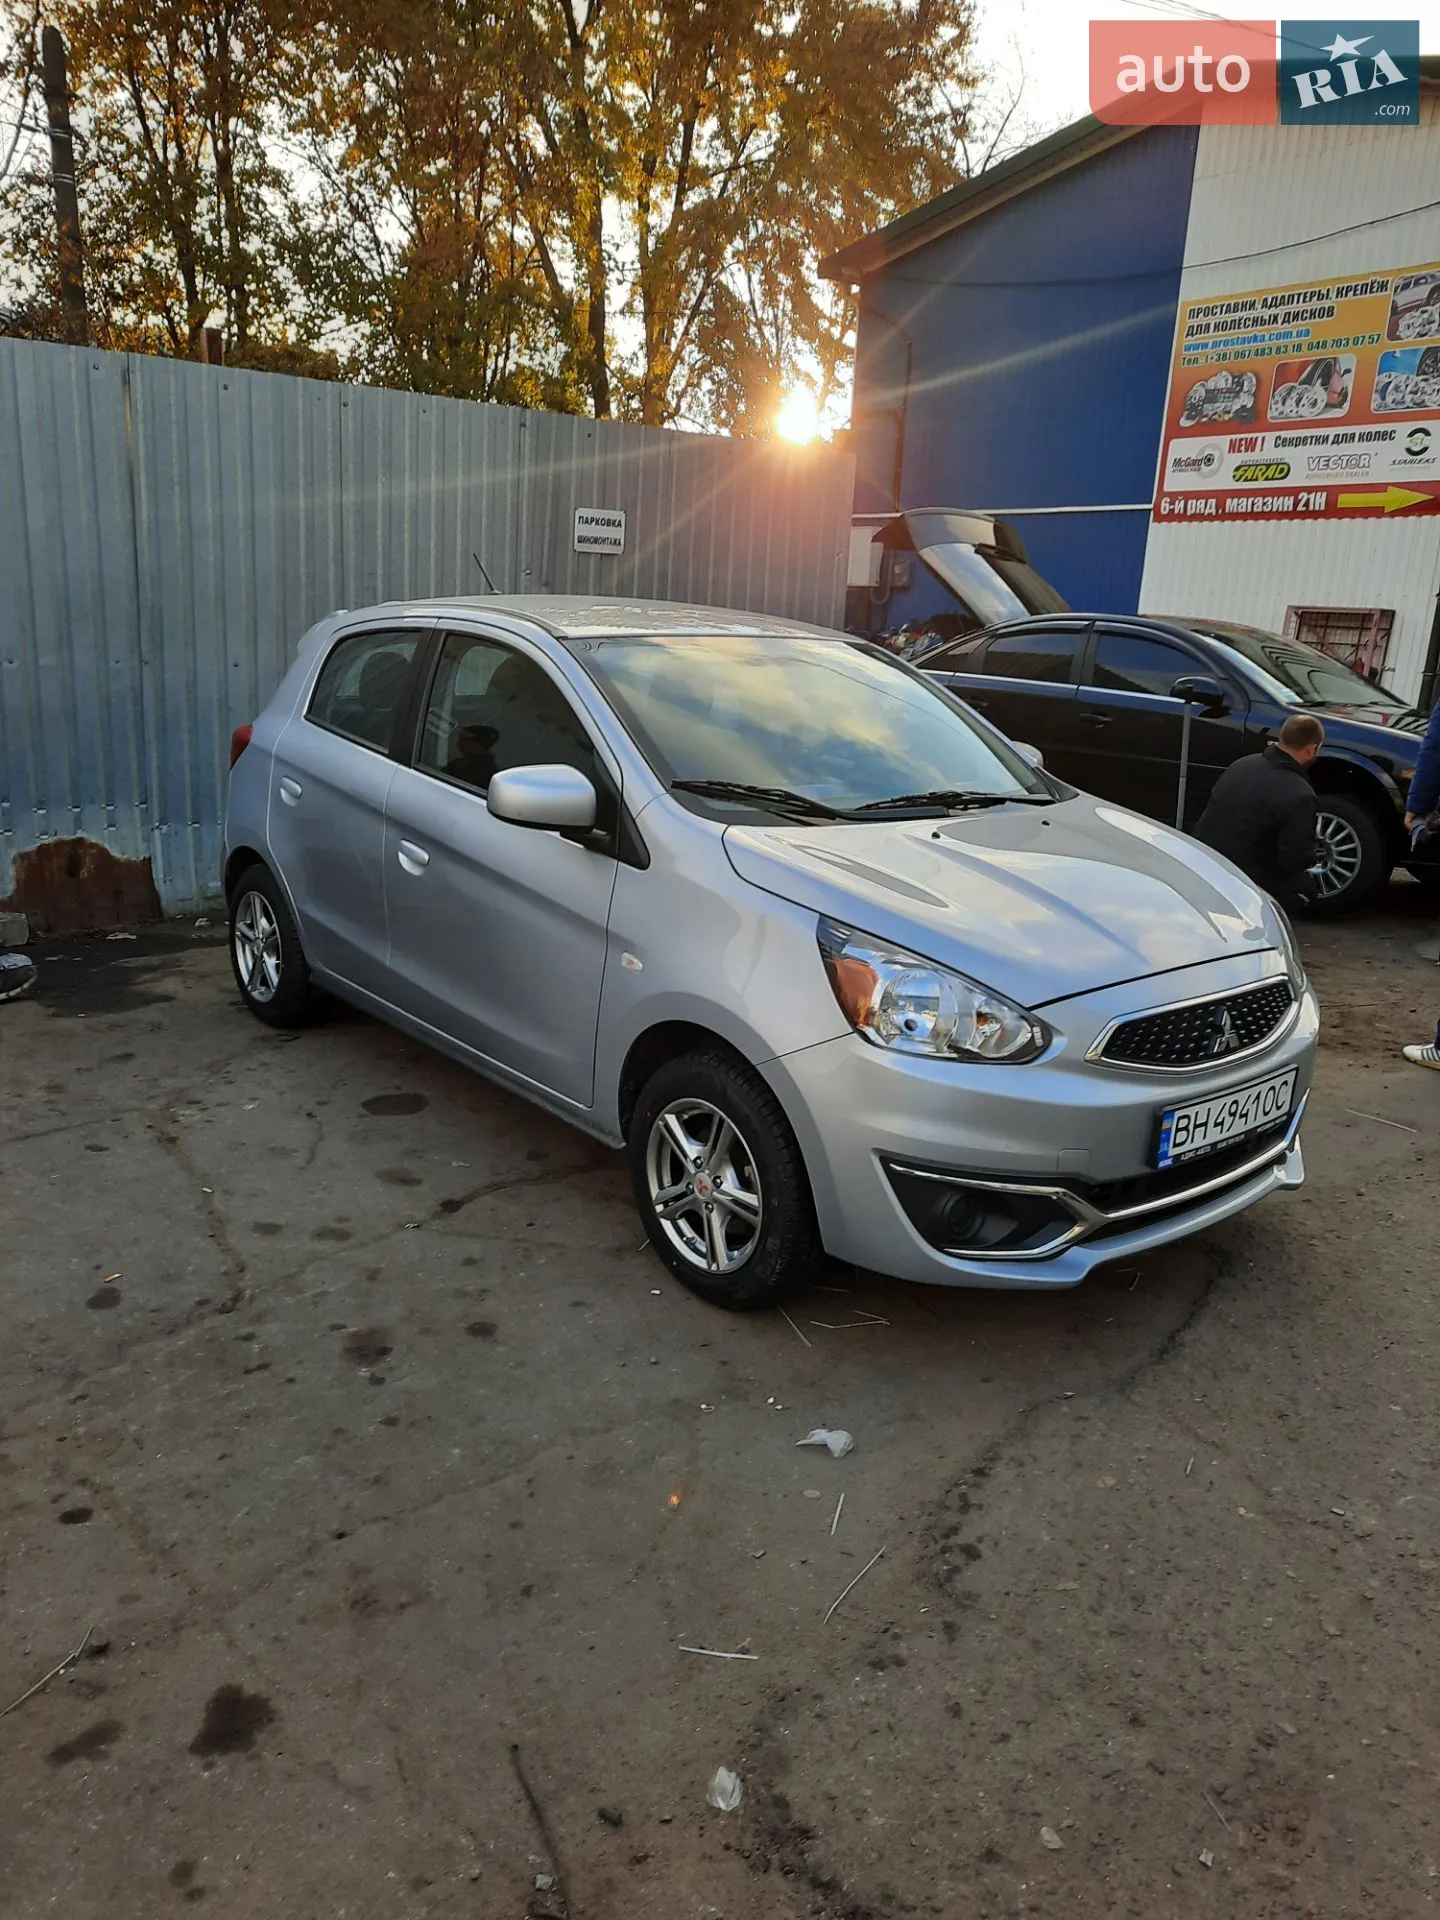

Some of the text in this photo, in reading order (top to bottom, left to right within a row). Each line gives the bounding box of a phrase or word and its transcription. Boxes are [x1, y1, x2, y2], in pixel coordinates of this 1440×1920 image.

[1188, 279, 1390, 320] ПРОСТАВКИ, АДАПТЕРЫ, КРЕПЁЖ
[1185, 305, 1336, 338] ДЛЯ КОЛЁСНЫХ ДИСКОВ
[1183, 328, 1311, 352] www.prostavka.com.ua
[1233, 349, 1252, 360] 067
[1253, 347, 1273, 357] 483
[1307, 340, 1328, 351] 048
[1330, 337, 1350, 348] 703
[1352, 335, 1366, 347] 07
[1367, 333, 1381, 345] 57
[1273, 429, 1397, 448] Секретки для колес
[1307, 453, 1371, 471] VECTOR
[1234, 464, 1288, 481] FARAD
[1160, 496, 1184, 515] 6-й
[1225, 495, 1294, 513] магазин
[578, 515, 622, 528] ПАРКОВКА
